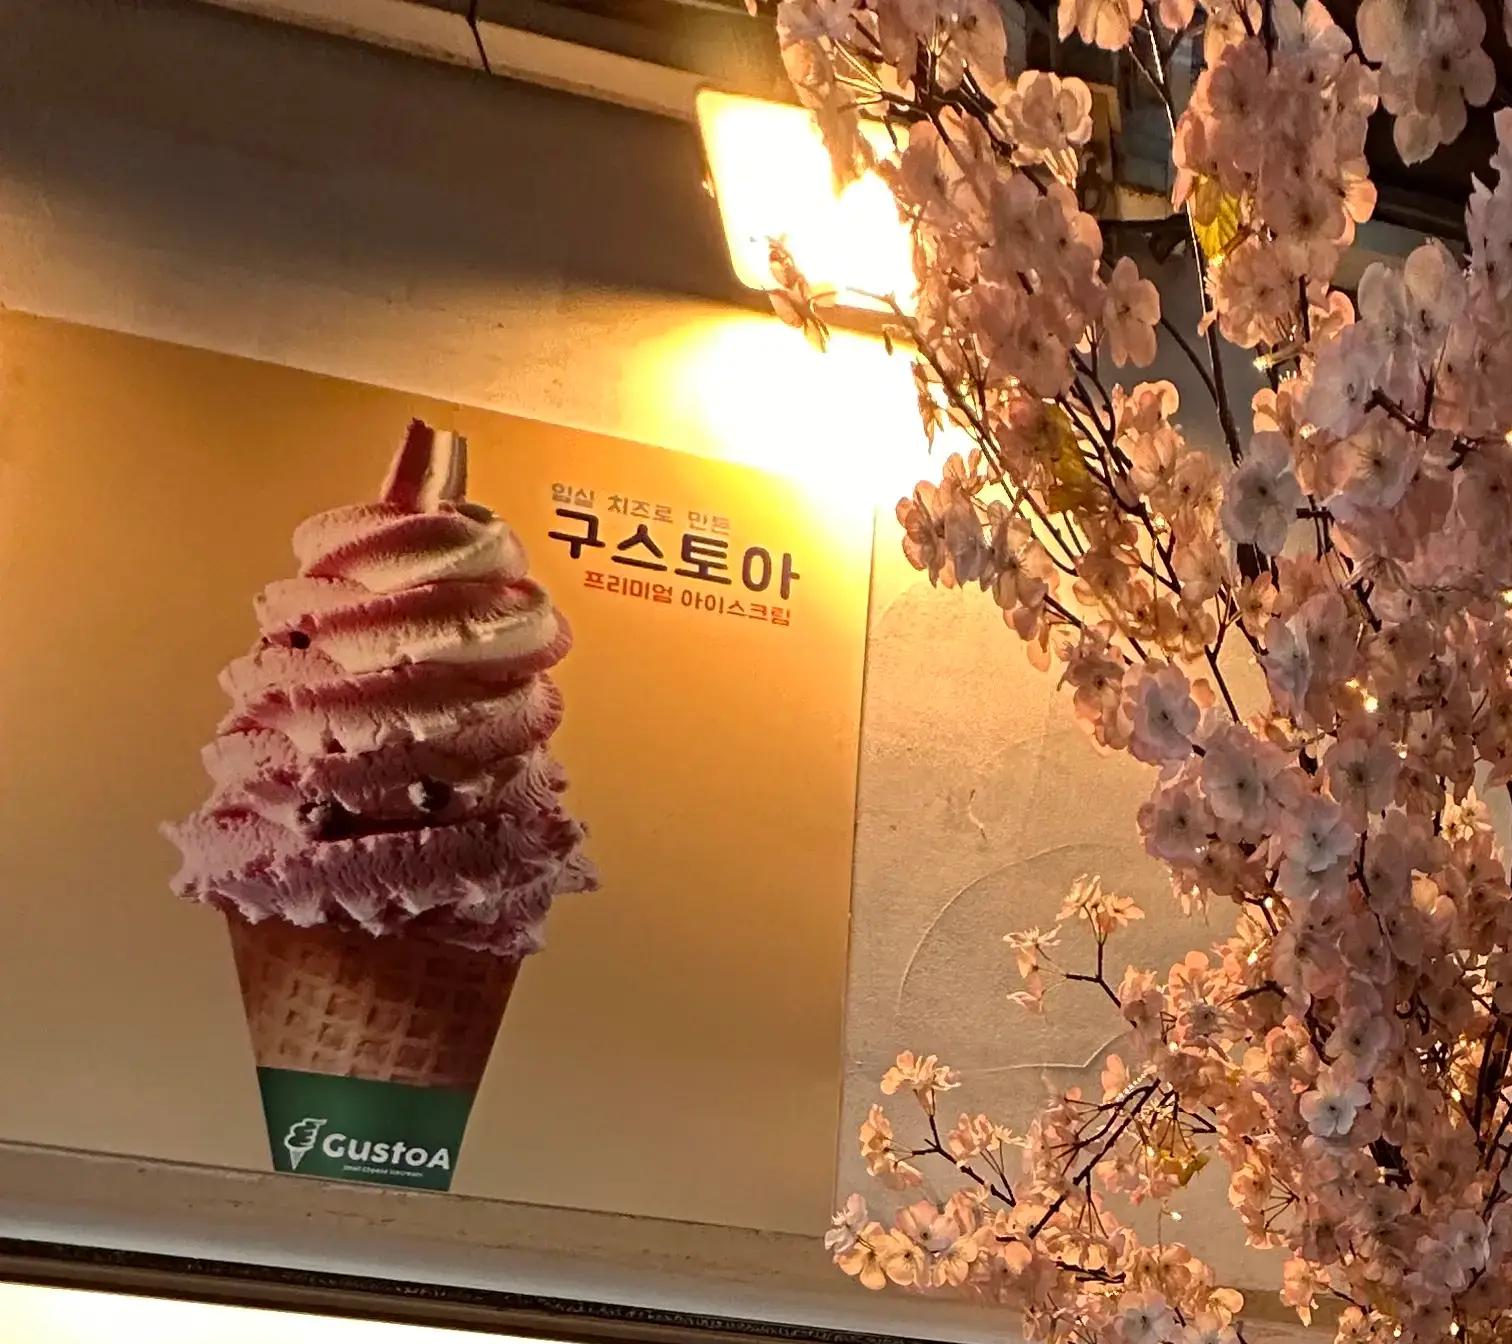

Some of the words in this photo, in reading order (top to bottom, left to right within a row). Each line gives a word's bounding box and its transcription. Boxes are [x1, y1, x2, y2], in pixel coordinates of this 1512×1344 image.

[608, 494, 674, 525] 치즈로
[548, 507, 801, 600] 구스토아
[584, 570, 673, 604] 프리미엄
[681, 589, 791, 627] 아이스크림
[322, 1132, 450, 1170] GustoA
